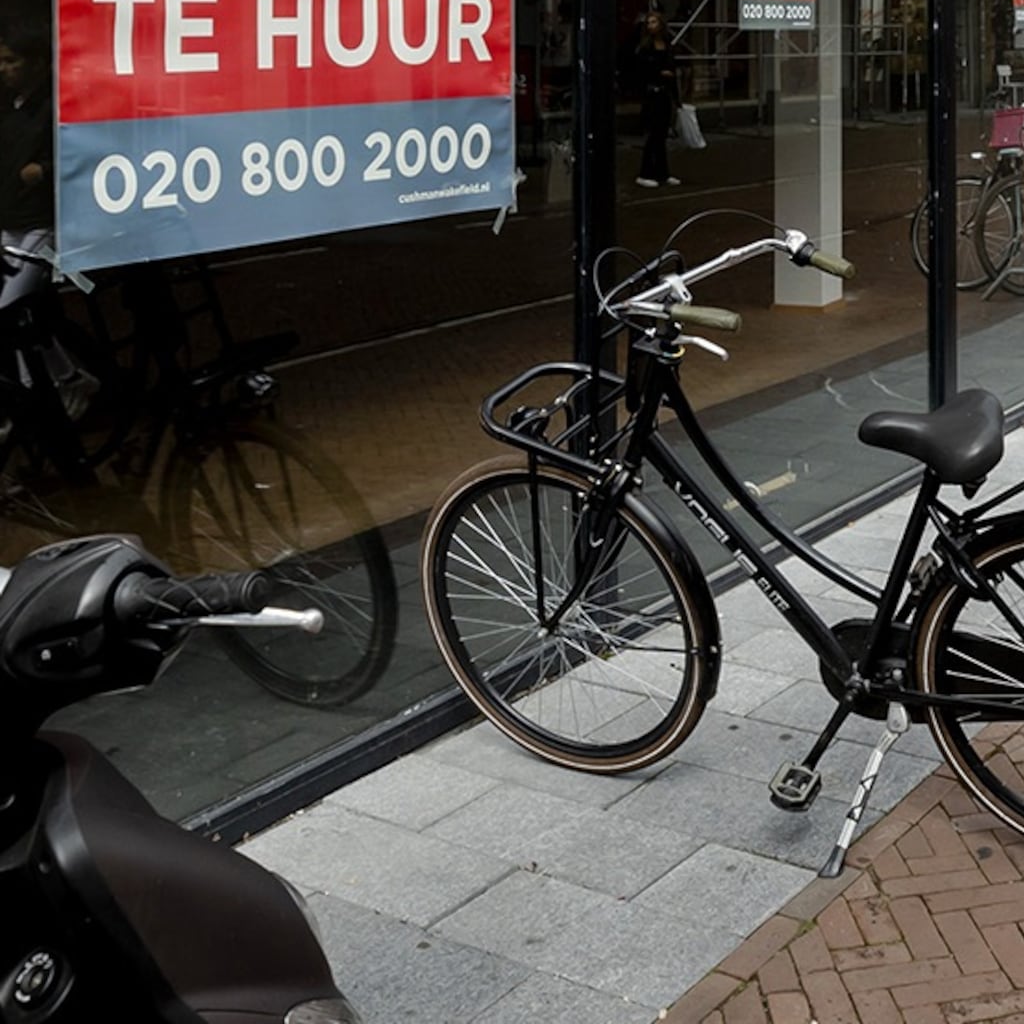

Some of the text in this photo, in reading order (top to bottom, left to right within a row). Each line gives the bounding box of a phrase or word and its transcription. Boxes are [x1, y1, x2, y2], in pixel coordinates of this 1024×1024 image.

[742, 3, 763, 19] 020
[785, 4, 812, 20] 2000
[93, 122, 492, 214] 020 800 2000
